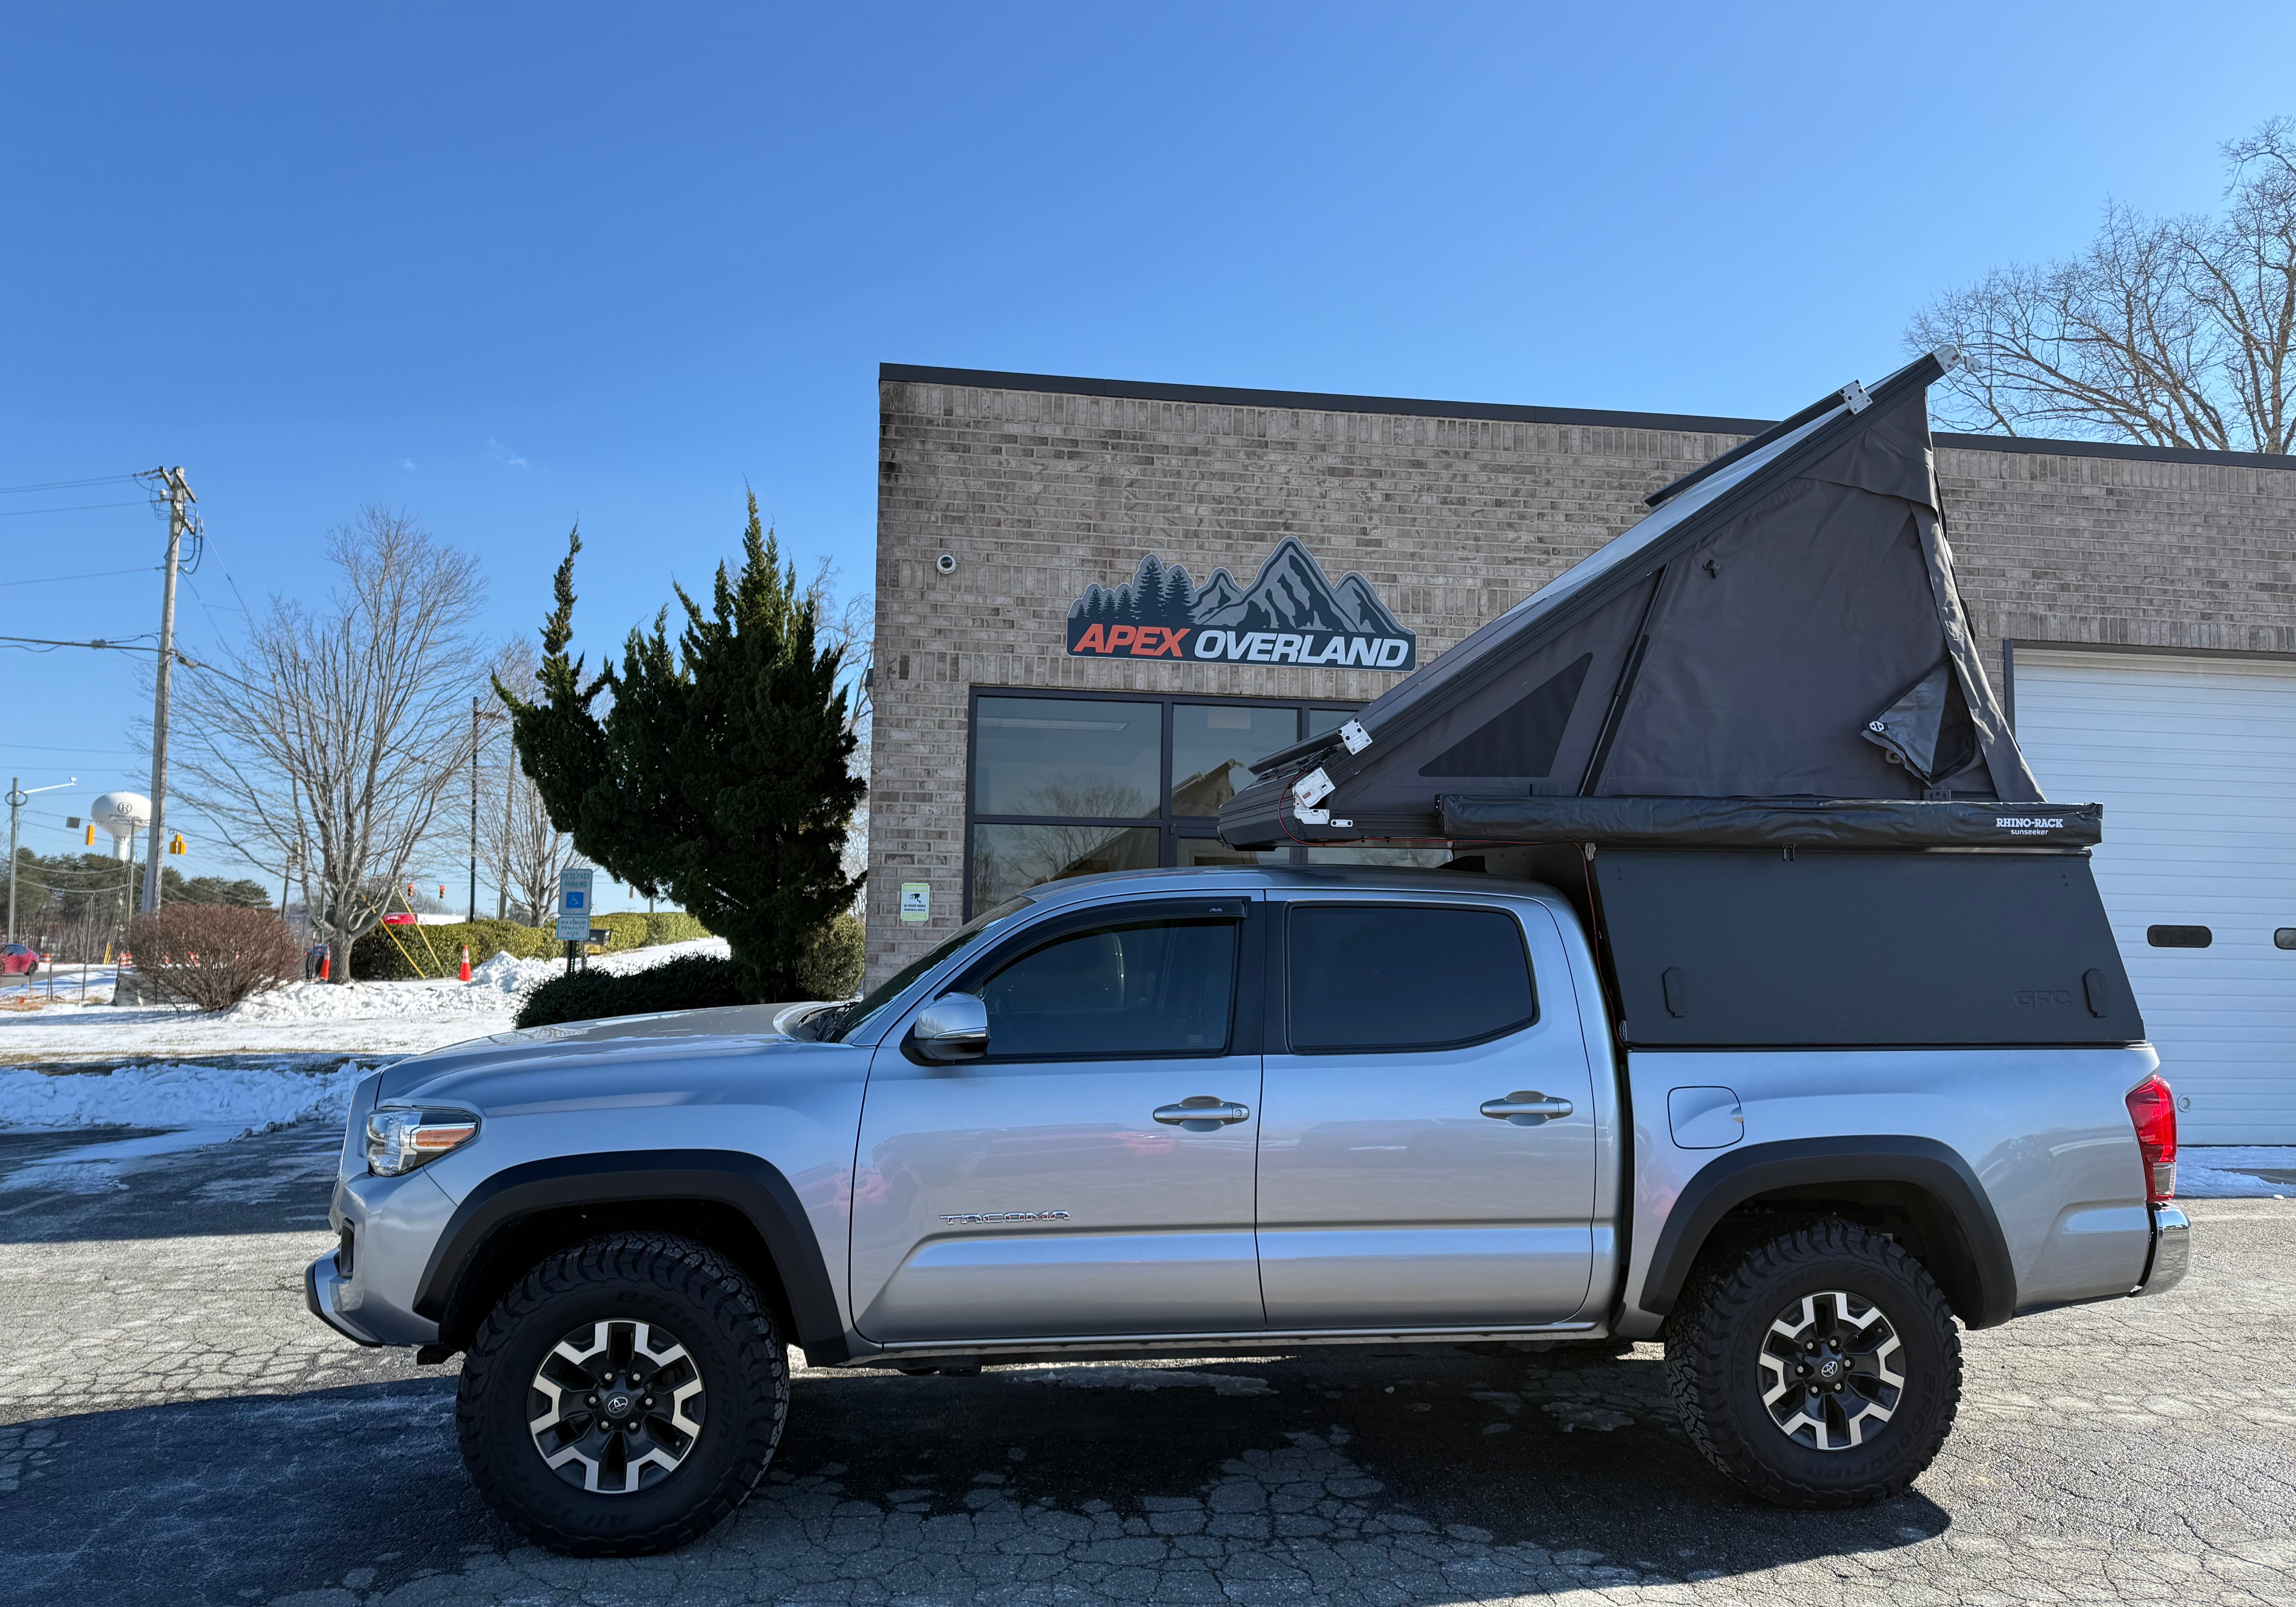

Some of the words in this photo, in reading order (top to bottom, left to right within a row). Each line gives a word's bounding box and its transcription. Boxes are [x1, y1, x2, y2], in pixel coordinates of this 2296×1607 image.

[1072, 623, 1191, 658] APEX
[1194, 630, 1409, 667] OVERLAND
[1996, 818, 2063, 828] RHINO-RACK
[2014, 990, 2072, 1008] GFC
[939, 1210, 1070, 1225] TACOMA
